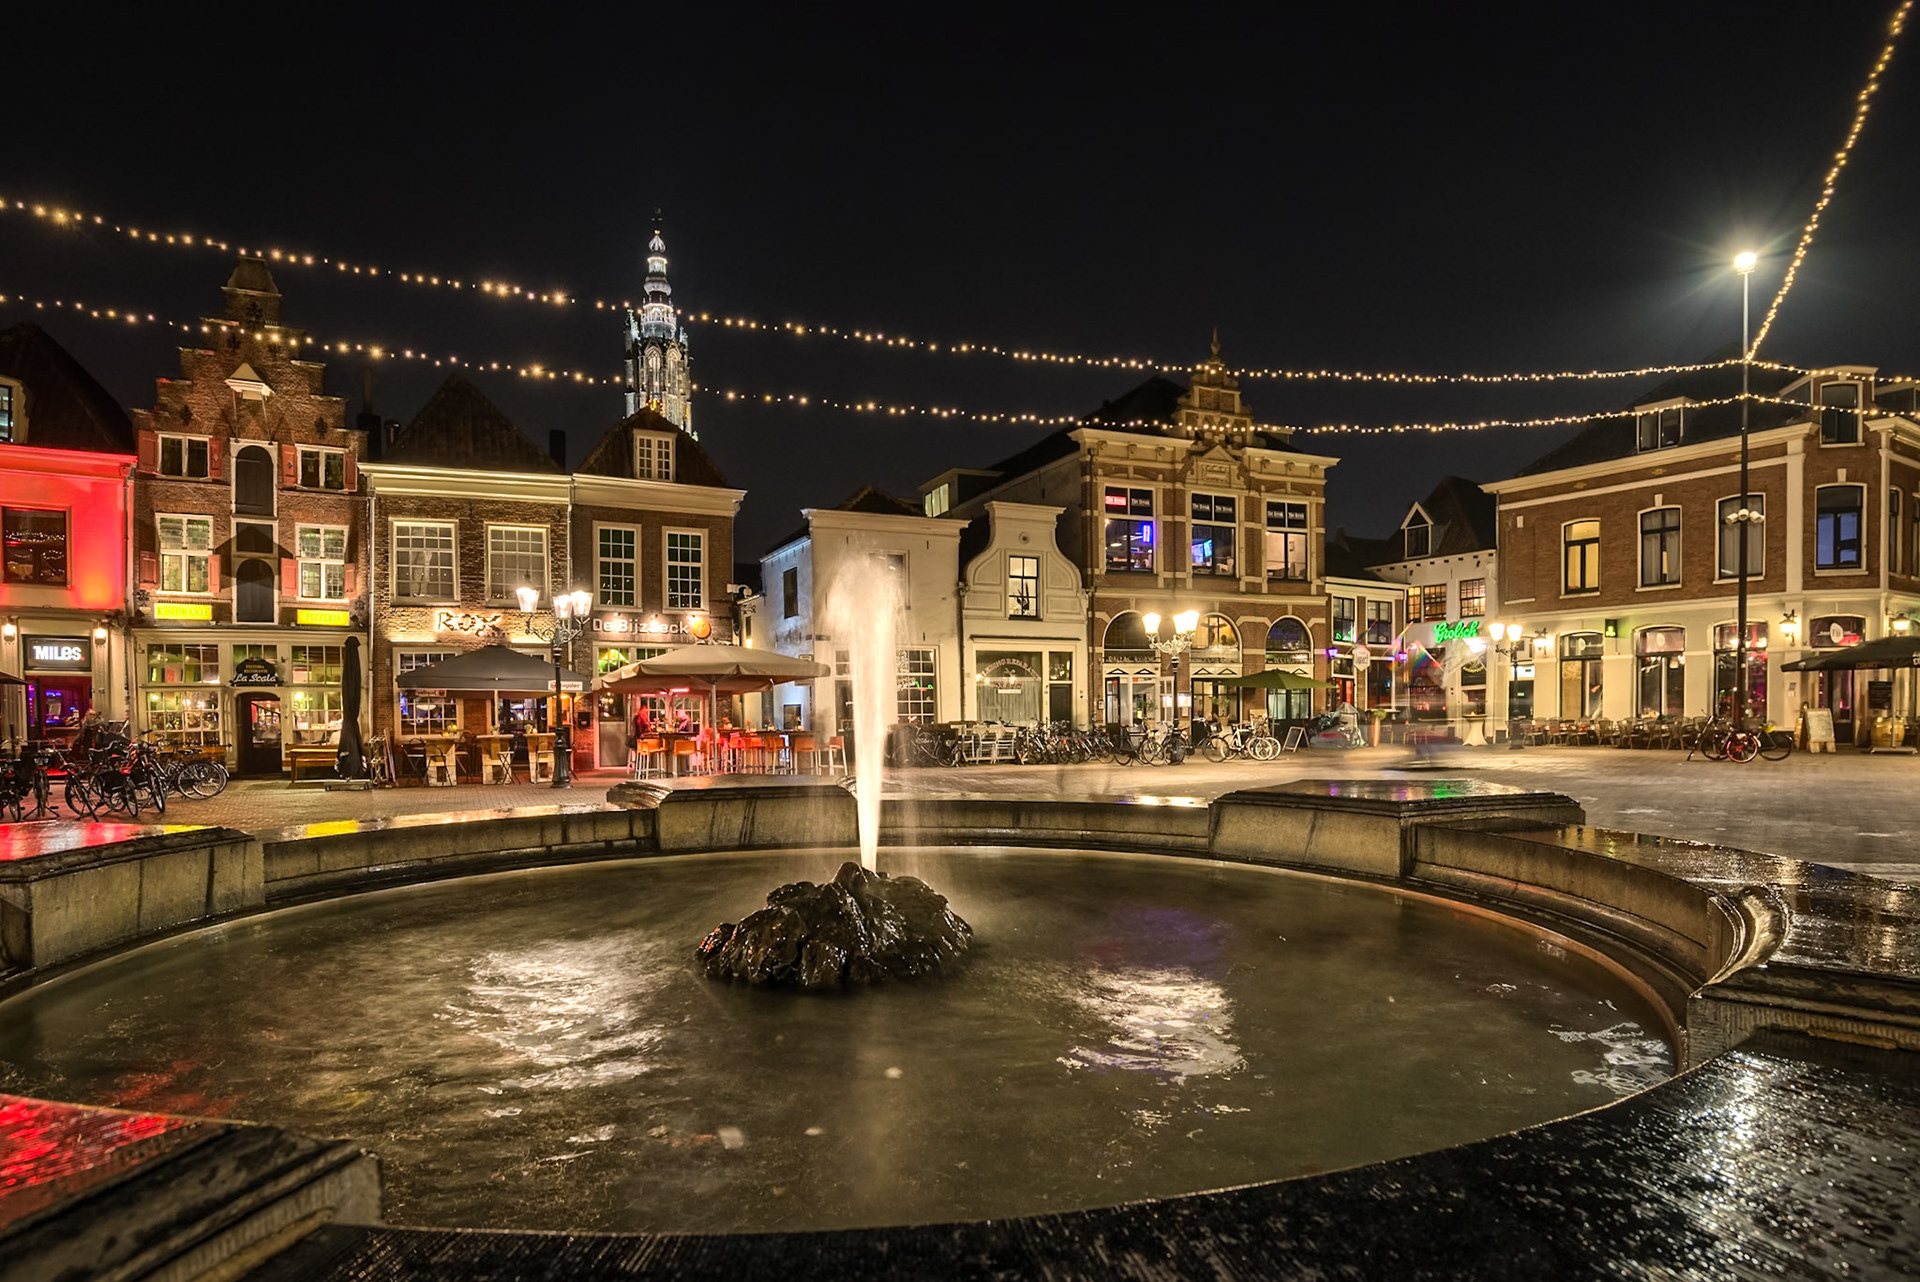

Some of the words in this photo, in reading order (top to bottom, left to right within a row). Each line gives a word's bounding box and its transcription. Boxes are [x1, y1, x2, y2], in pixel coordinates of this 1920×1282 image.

[593, 619, 613, 631] De
[1433, 620, 1479, 644] Grolsch
[234, 673, 248, 683] La
[249, 673, 277, 682] Scala
